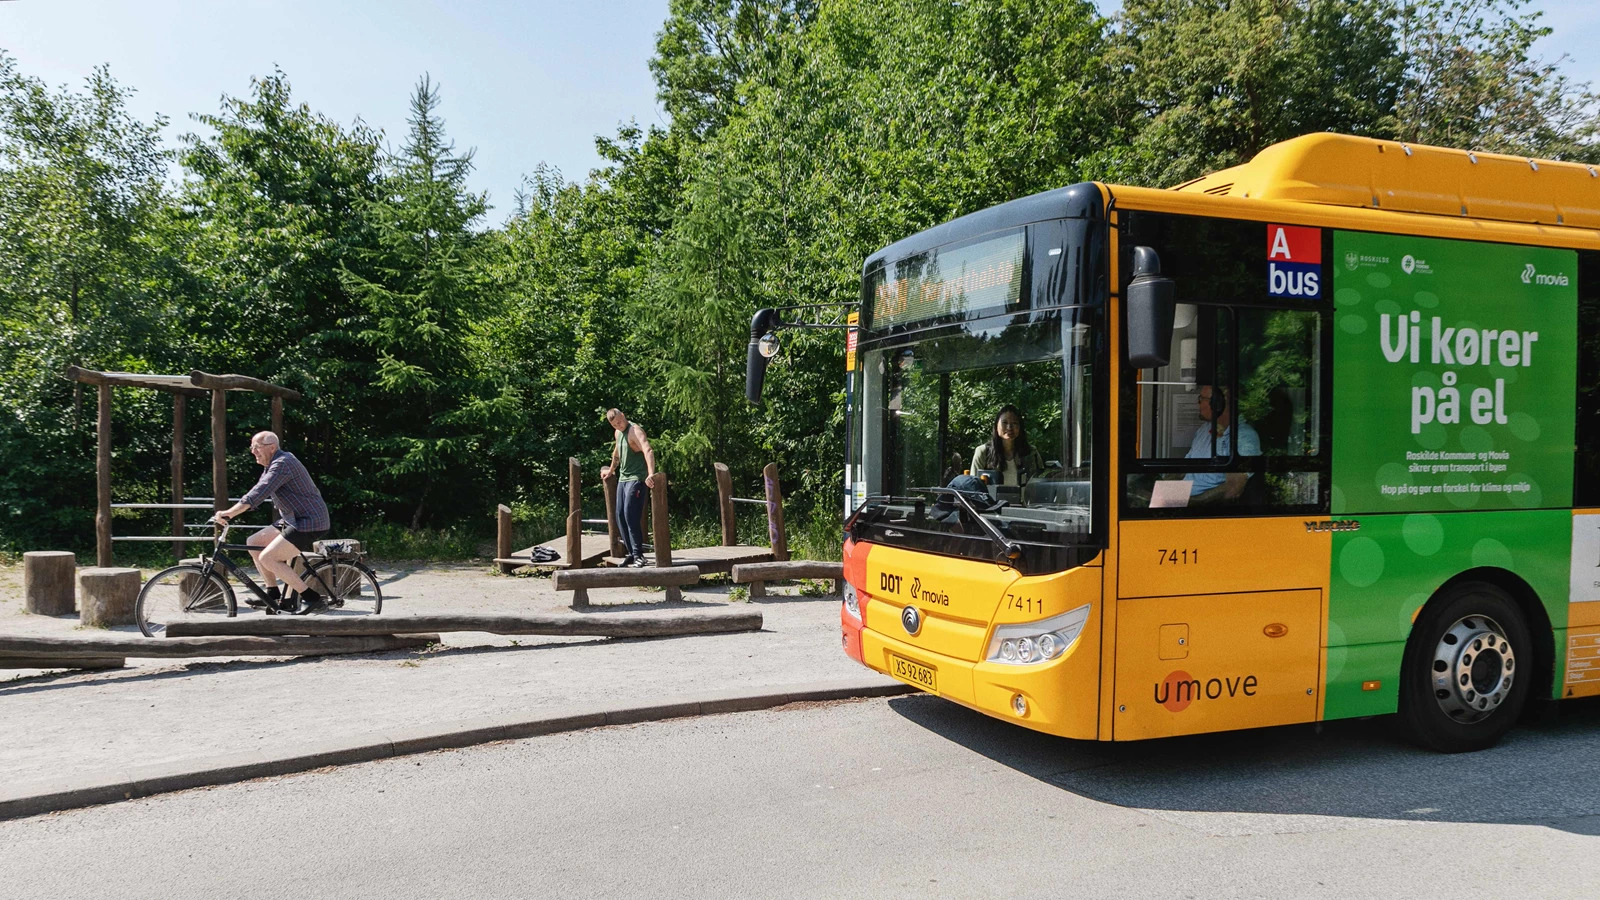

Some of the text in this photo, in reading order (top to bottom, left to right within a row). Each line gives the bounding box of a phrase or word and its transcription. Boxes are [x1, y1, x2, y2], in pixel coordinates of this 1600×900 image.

[1270, 227, 1291, 259] A
[1269, 262, 1319, 296] bus
[1535, 272, 1569, 286] movia
[1380, 310, 1539, 367] Vi kører
[1411, 371, 1508, 434] på el
[1406, 450, 1510, 461] Roskilde Kommune og Movia
[1408, 462, 1431, 473] sikrer
[1449, 463, 1484, 474] transport
[1489, 463, 1507, 473] byen
[1381, 485, 1397, 495] Hop
[1397, 483, 1407, 495] på
[1408, 486, 1418, 495] og
[1432, 485, 1442, 493] en
[1443, 483, 1469, 493] forskel
[1469, 483, 1481, 493] for
[1481, 482, 1502, 492] klima
[1502, 484, 1512, 493] og
[1303, 520, 1361, 532] YUTONG
[1157, 549, 1198, 565] 7411
[880, 572, 949, 606] DOT movia
[1007, 594, 1043, 614] 7411
[895, 660, 933, 686] XS 92 683
[1153, 673, 1258, 704] umove
